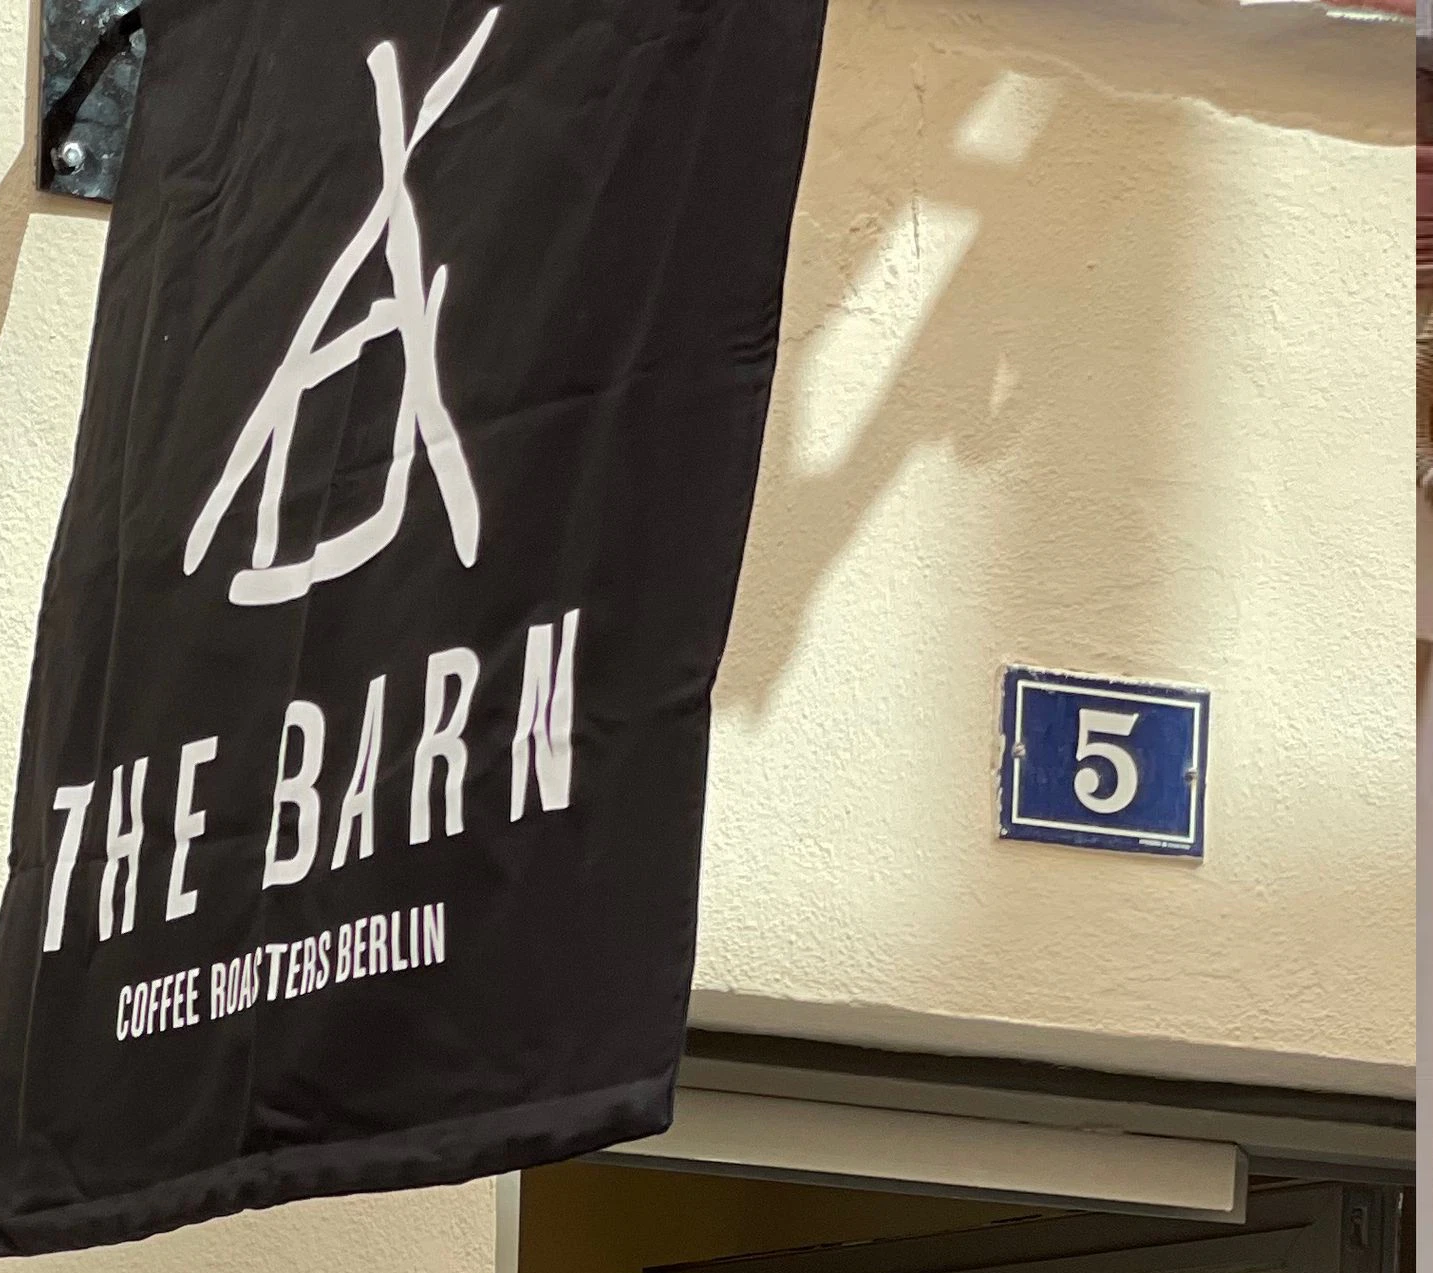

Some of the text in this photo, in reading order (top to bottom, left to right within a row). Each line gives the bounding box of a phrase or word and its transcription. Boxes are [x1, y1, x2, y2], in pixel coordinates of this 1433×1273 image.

[43, 608, 580, 952] THE BARN
[1074, 708, 1139, 814] 5
[116, 902, 446, 1041] COFFEE ROASTERS BERLIN
